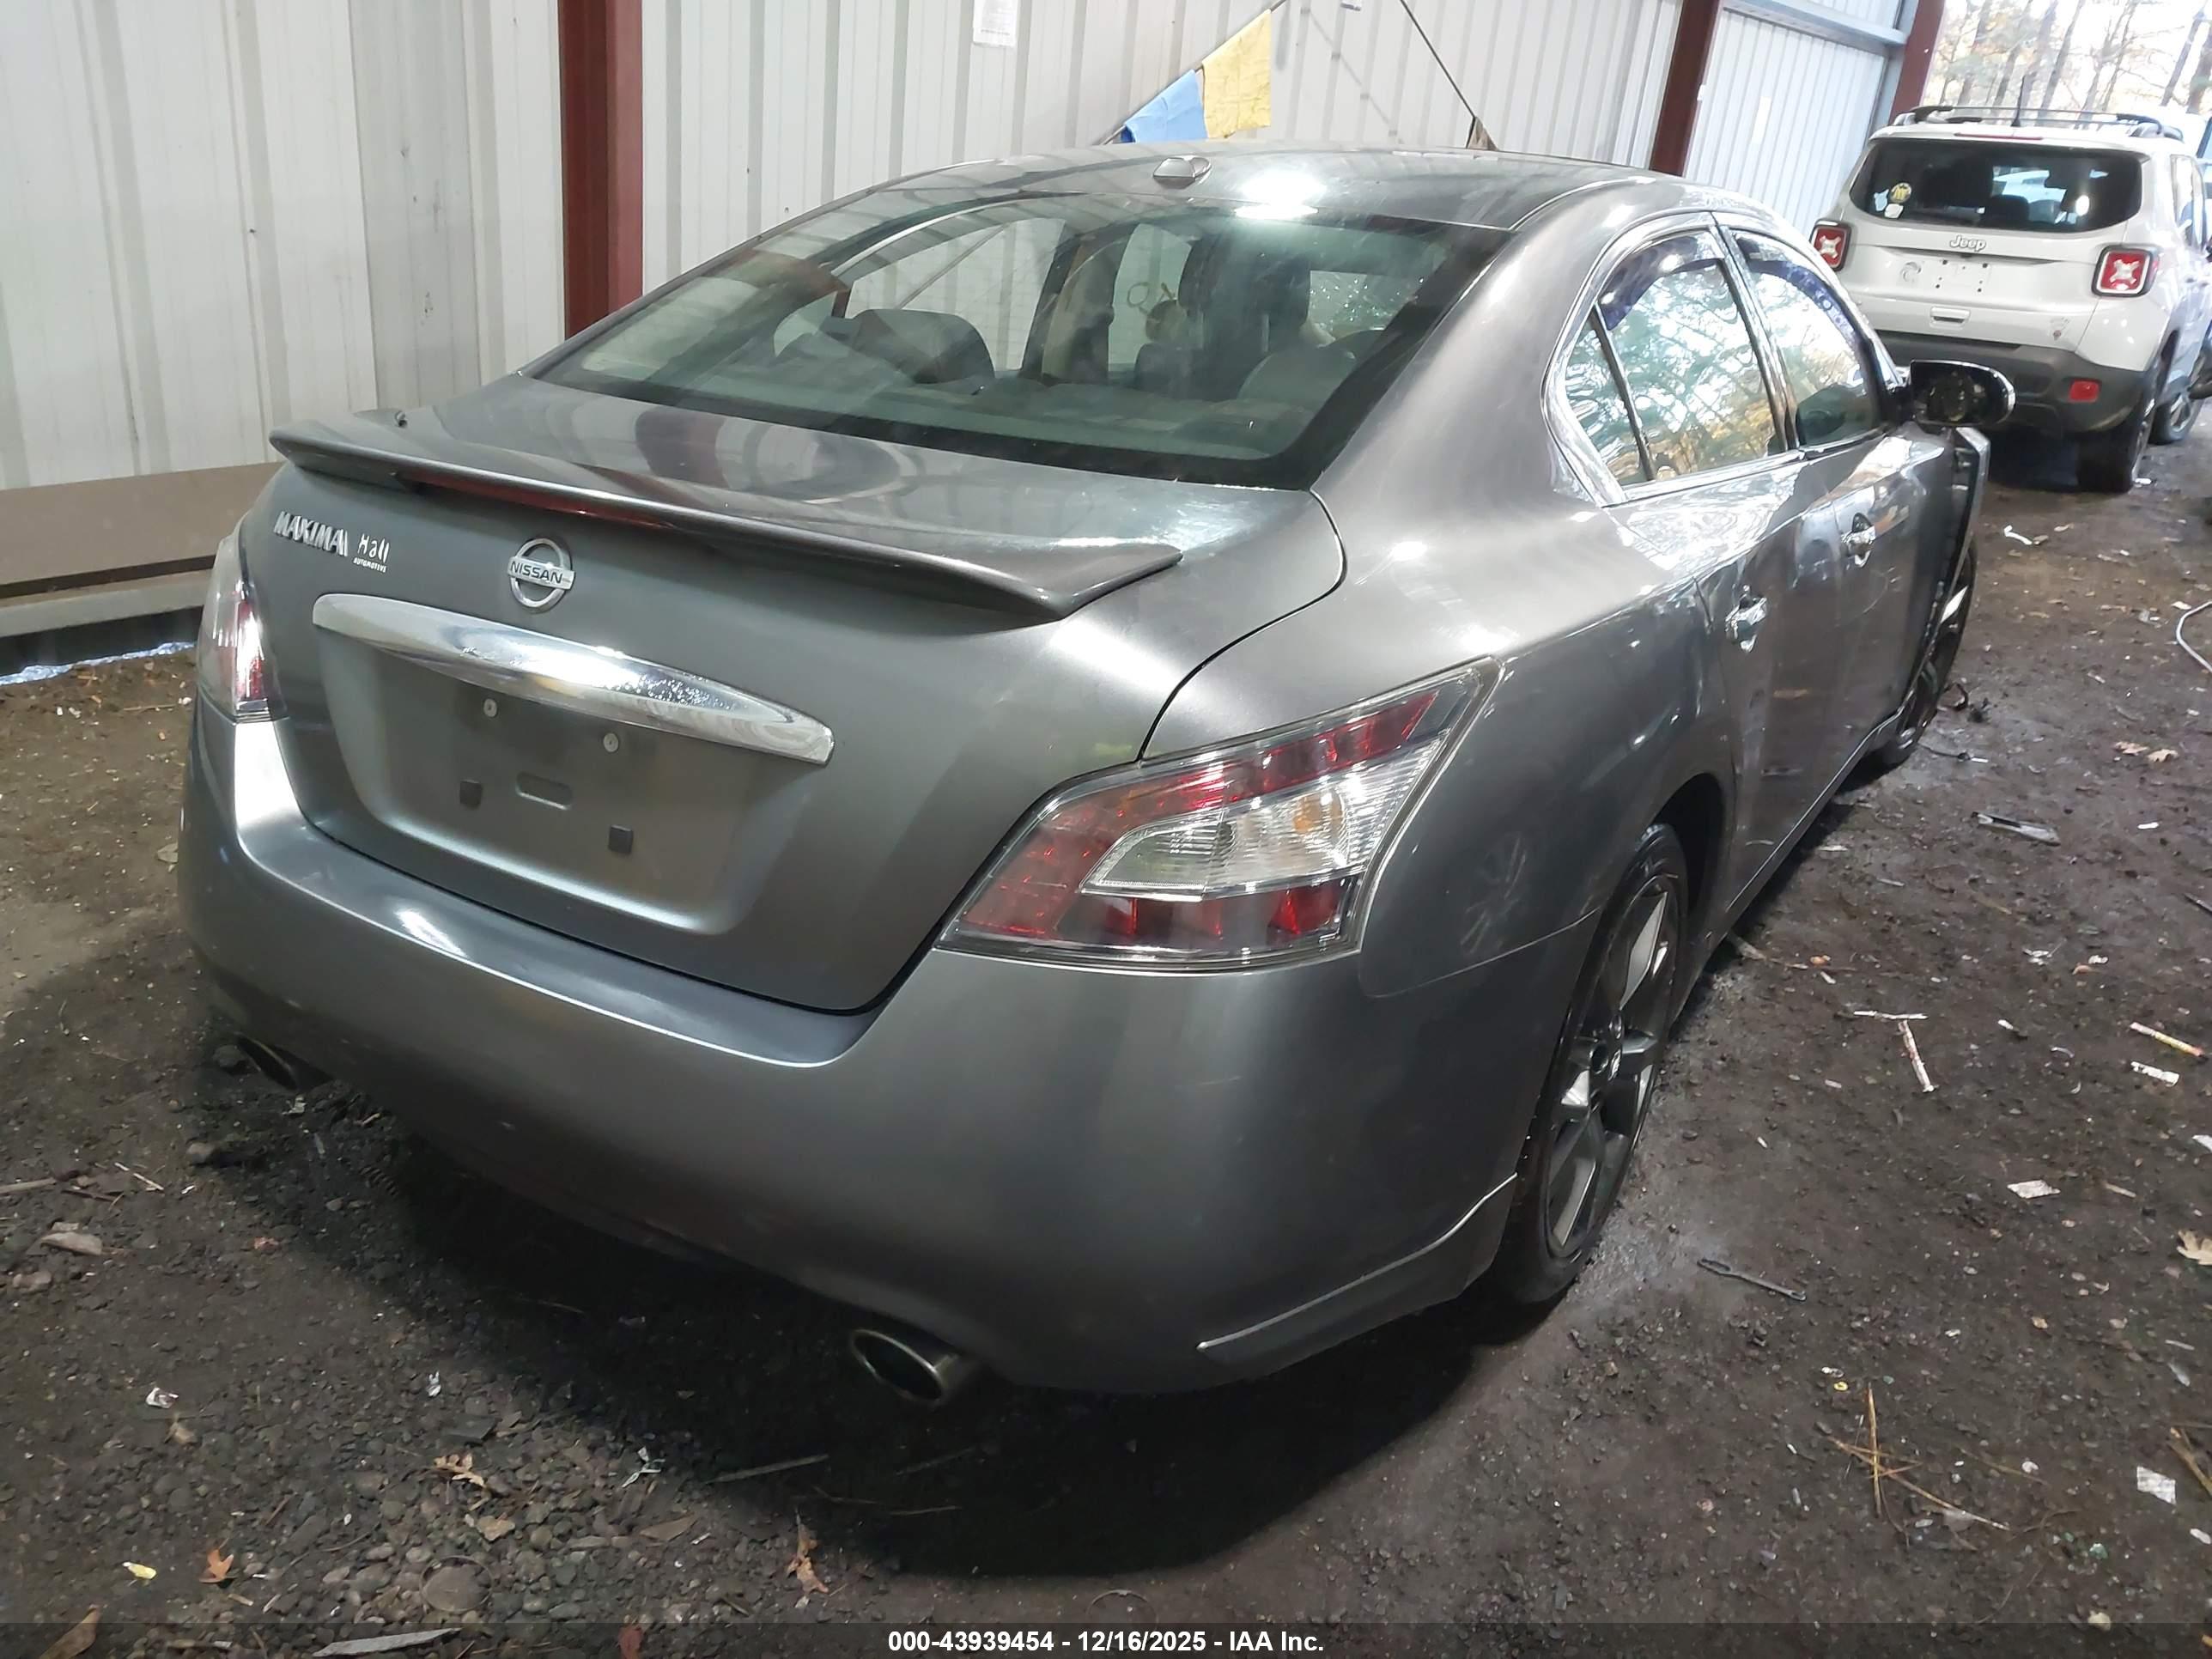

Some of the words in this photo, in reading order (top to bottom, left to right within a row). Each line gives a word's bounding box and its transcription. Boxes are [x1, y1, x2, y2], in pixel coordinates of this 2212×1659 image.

[1949, 234, 1986, 252] Jeep
[274, 511, 348, 556] MAXIMA
[357, 533, 390, 563] Hall
[511, 561, 563, 584] NISSAN
